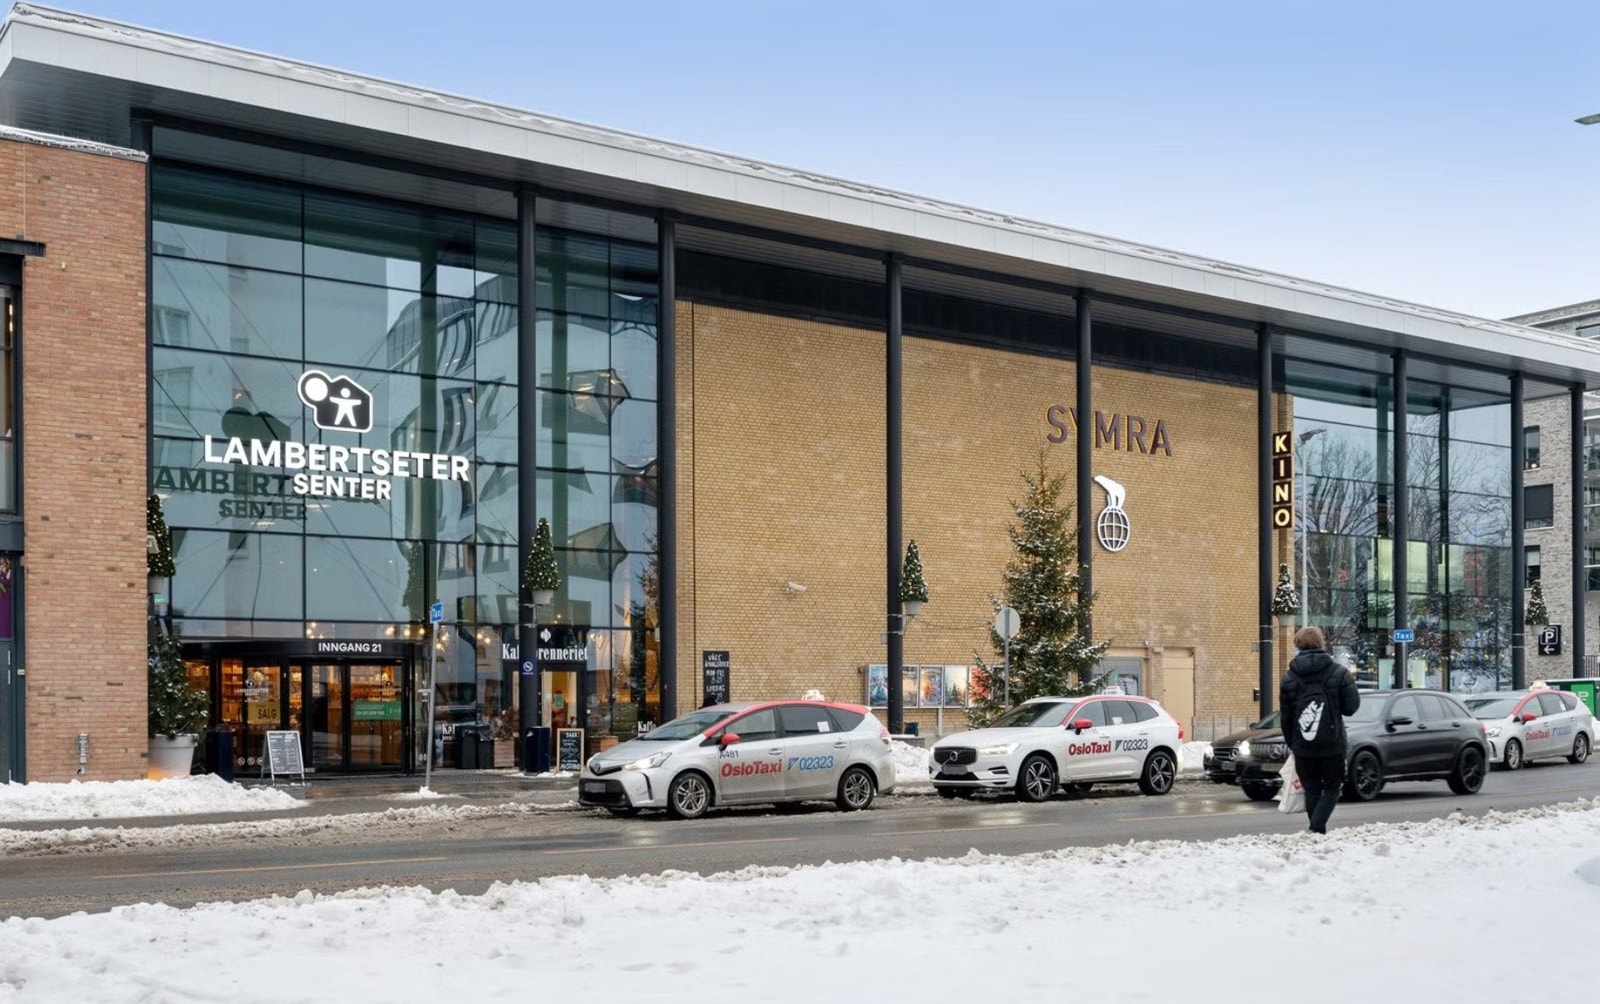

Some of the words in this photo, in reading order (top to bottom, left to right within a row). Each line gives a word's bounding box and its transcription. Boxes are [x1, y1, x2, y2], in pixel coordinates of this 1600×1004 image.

[204, 435, 470, 481] LAMBERTSETER
[293, 472, 391, 500] SENTER
[1275, 434, 1291, 527] KINO
[1396, 631, 1412, 640] Taxi
[1545, 631, 1554, 643] P
[318, 642, 370, 652] INNGANG
[372, 643, 382, 653] 21
[257, 708, 277, 719] SALG
[1525, 729, 1550, 741] OsloTaxi
[1068, 741, 1112, 756] OsloTaxi
[1122, 739, 1148, 751] 02323
[720, 759, 782, 778] OsloTaxi
[799, 755, 834, 771] 02323
